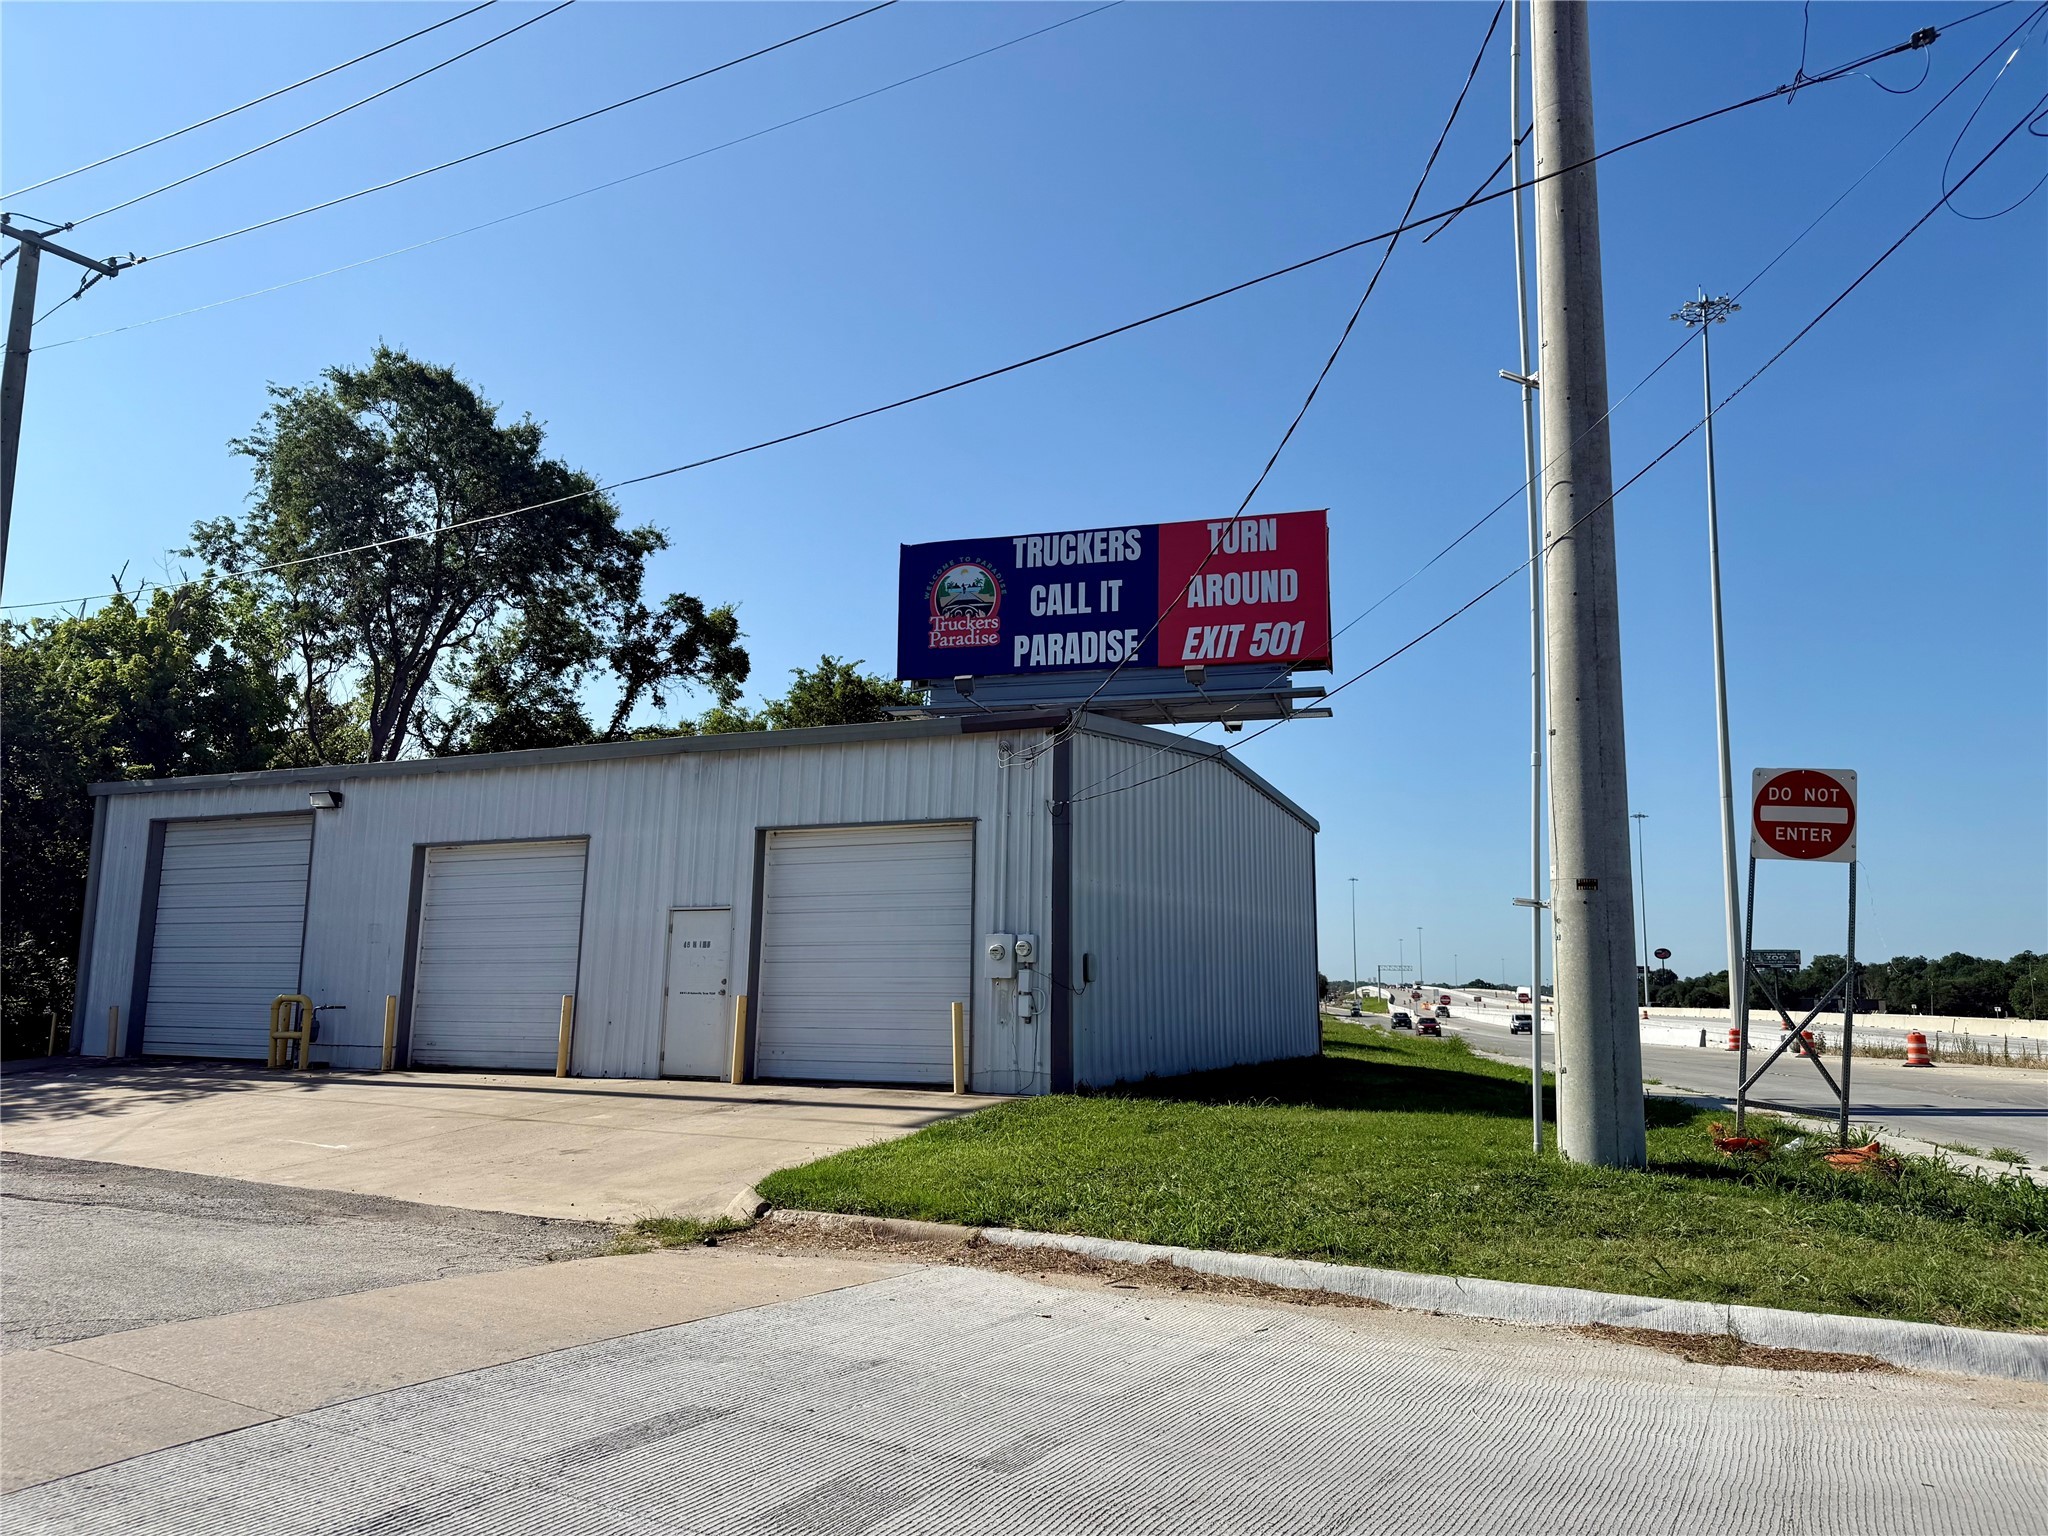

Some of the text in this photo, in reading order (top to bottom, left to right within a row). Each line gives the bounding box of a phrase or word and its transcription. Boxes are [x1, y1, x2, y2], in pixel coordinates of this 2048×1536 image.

[1013, 528, 1141, 569] TRUCKERS
[1207, 518, 1277, 555] TURN
[924, 559, 954, 600] WELCOME
[975, 557, 1007, 595] PARADISE
[1187, 568, 1298, 609] AROUND
[1030, 579, 1123, 617] CALL IT
[929, 629, 998, 647] Paradise
[930, 614, 999, 632] Truckers
[1181, 620, 1306, 660] EXIT 501
[1013, 629, 1139, 667] PARADISE
[1768, 787, 1840, 802] DO NOT
[1775, 826, 1832, 842] ENTER
